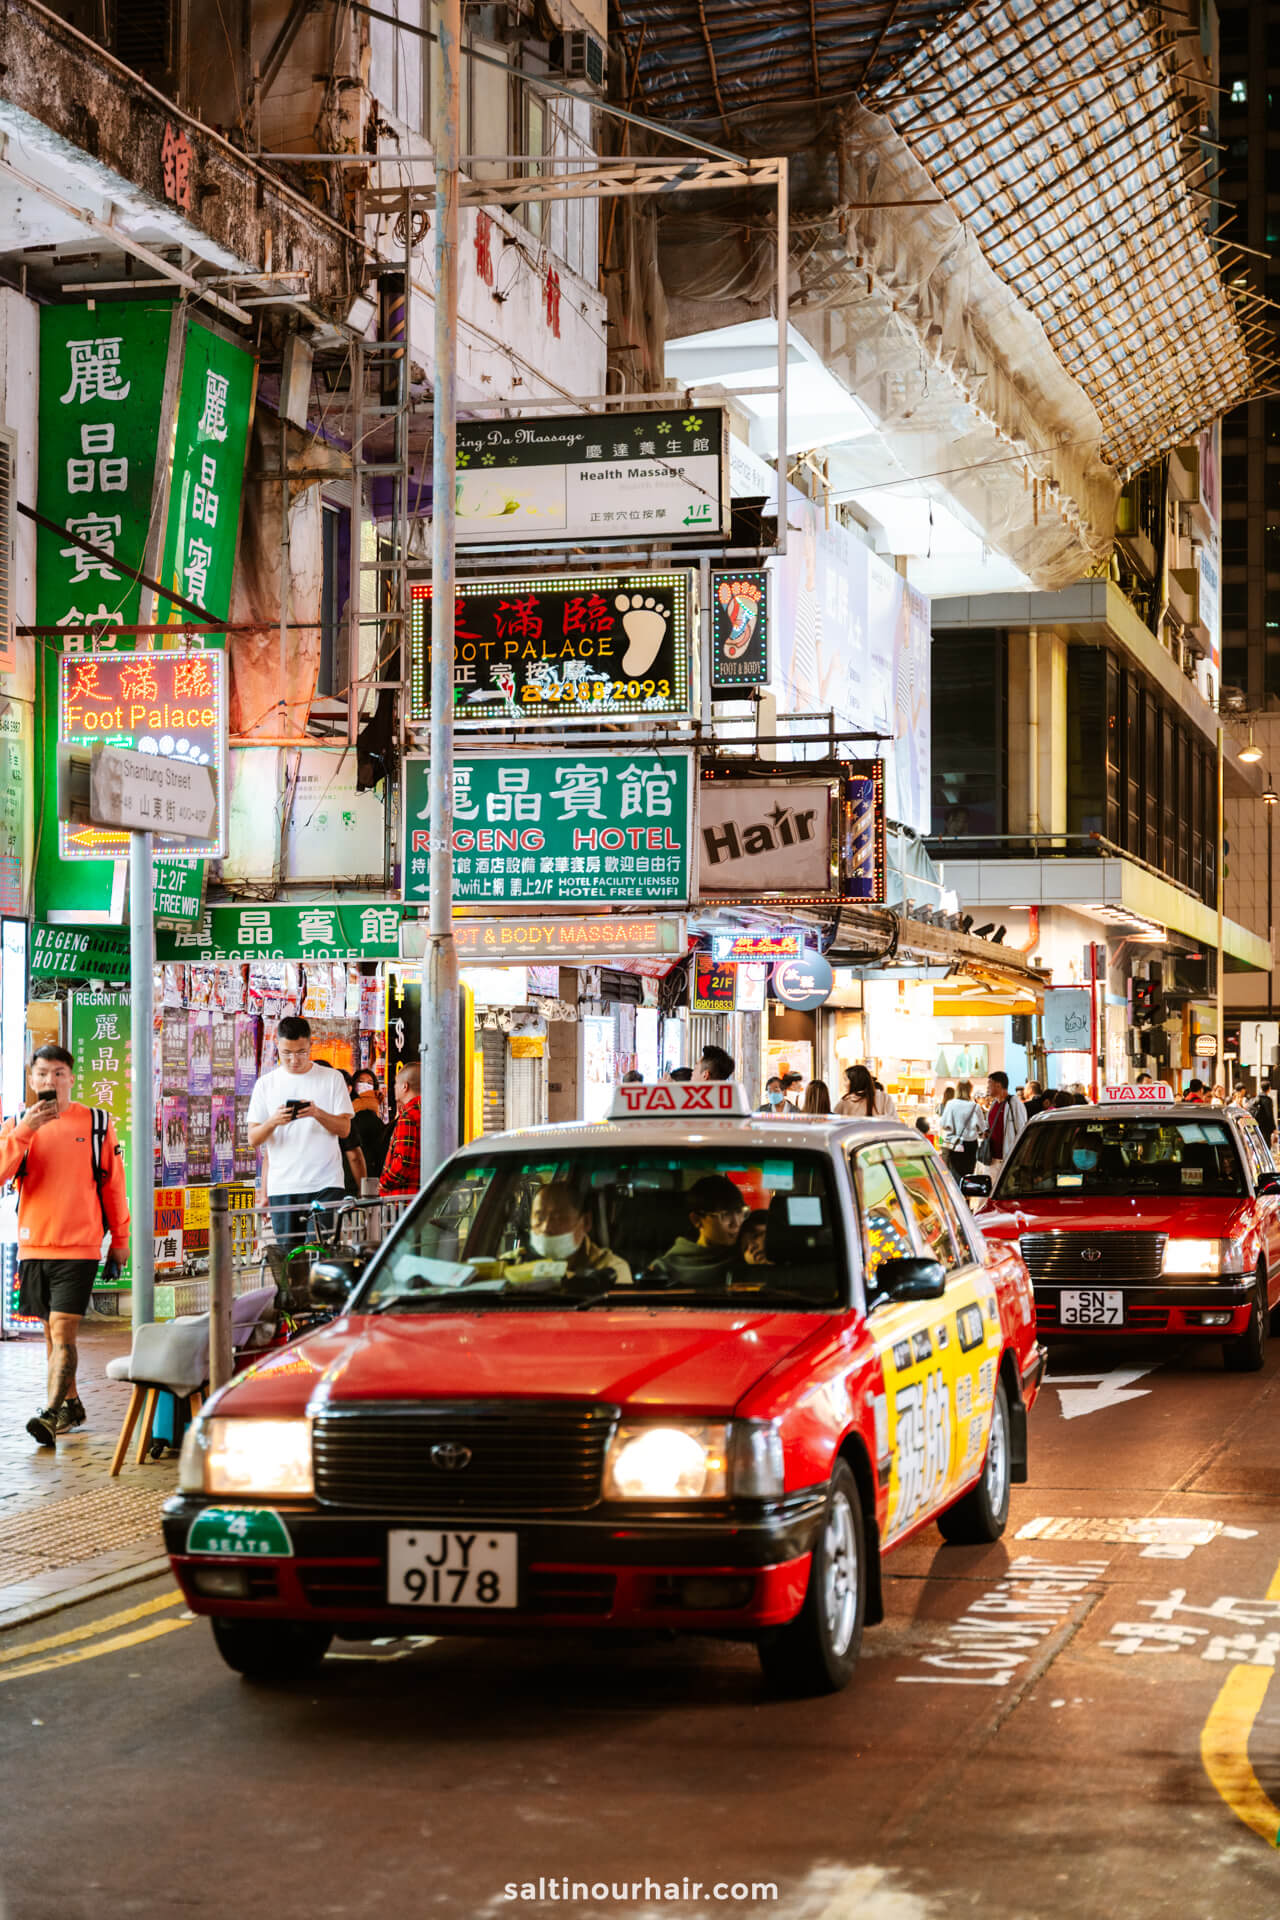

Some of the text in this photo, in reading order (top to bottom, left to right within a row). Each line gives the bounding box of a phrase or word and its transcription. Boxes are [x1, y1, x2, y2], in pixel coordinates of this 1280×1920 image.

[487, 430, 513, 446] Da
[515, 428, 585, 448] Massage
[585, 438, 710, 460] 慶達養生館
[580, 466, 685, 481] Health Massage
[590, 509, 667, 522] 正宗穴位按摩
[687, 504, 711, 517] 1/F
[504, 638, 615, 660] PALACE
[719, 661, 737, 676] FOOT
[744, 660, 761, 675] BODY
[69, 659, 213, 702] 足滿臨
[548, 679, 671, 701] 2388 2093
[68, 703, 218, 730] Foot Palace
[123, 759, 192, 789] Shantung Street
[139, 795, 176, 822] 山東街
[411, 827, 681, 852] RGENG HOTEL
[702, 803, 817, 866] Hair
[475, 856, 536, 874] 酒店設備
[539, 855, 601, 874] 豪華套房
[604, 855, 681, 873] 歡迎自由行
[168, 870, 187, 892] 2/F
[559, 876, 680, 887] HOTEL FACILITY LIENSED
[559, 887, 679, 897] HOTEL FREE WIFI
[159, 893, 181, 914] FREE
[182, 896, 199, 917] WIFI
[35, 929, 90, 953] REGENG
[484, 927, 496, 944] &
[501, 926, 555, 944] BODY
[559, 924, 657, 943] MASSAGE
[32, 950, 78, 973] HOTEL
[711, 977, 733, 989] 2/F
[76, 992, 118, 1006] REGRNT
[621, 1085, 733, 1110] TAXI
[1106, 1086, 1166, 1100] TAXI
[1079, 1292, 1105, 1307] SN
[1065, 1308, 1119, 1324] 3627
[228, 1515, 248, 1538] 4
[208, 1539, 270, 1553] SEATS
[425, 1534, 476, 1568] JY
[404, 1568, 500, 1604] 9178
